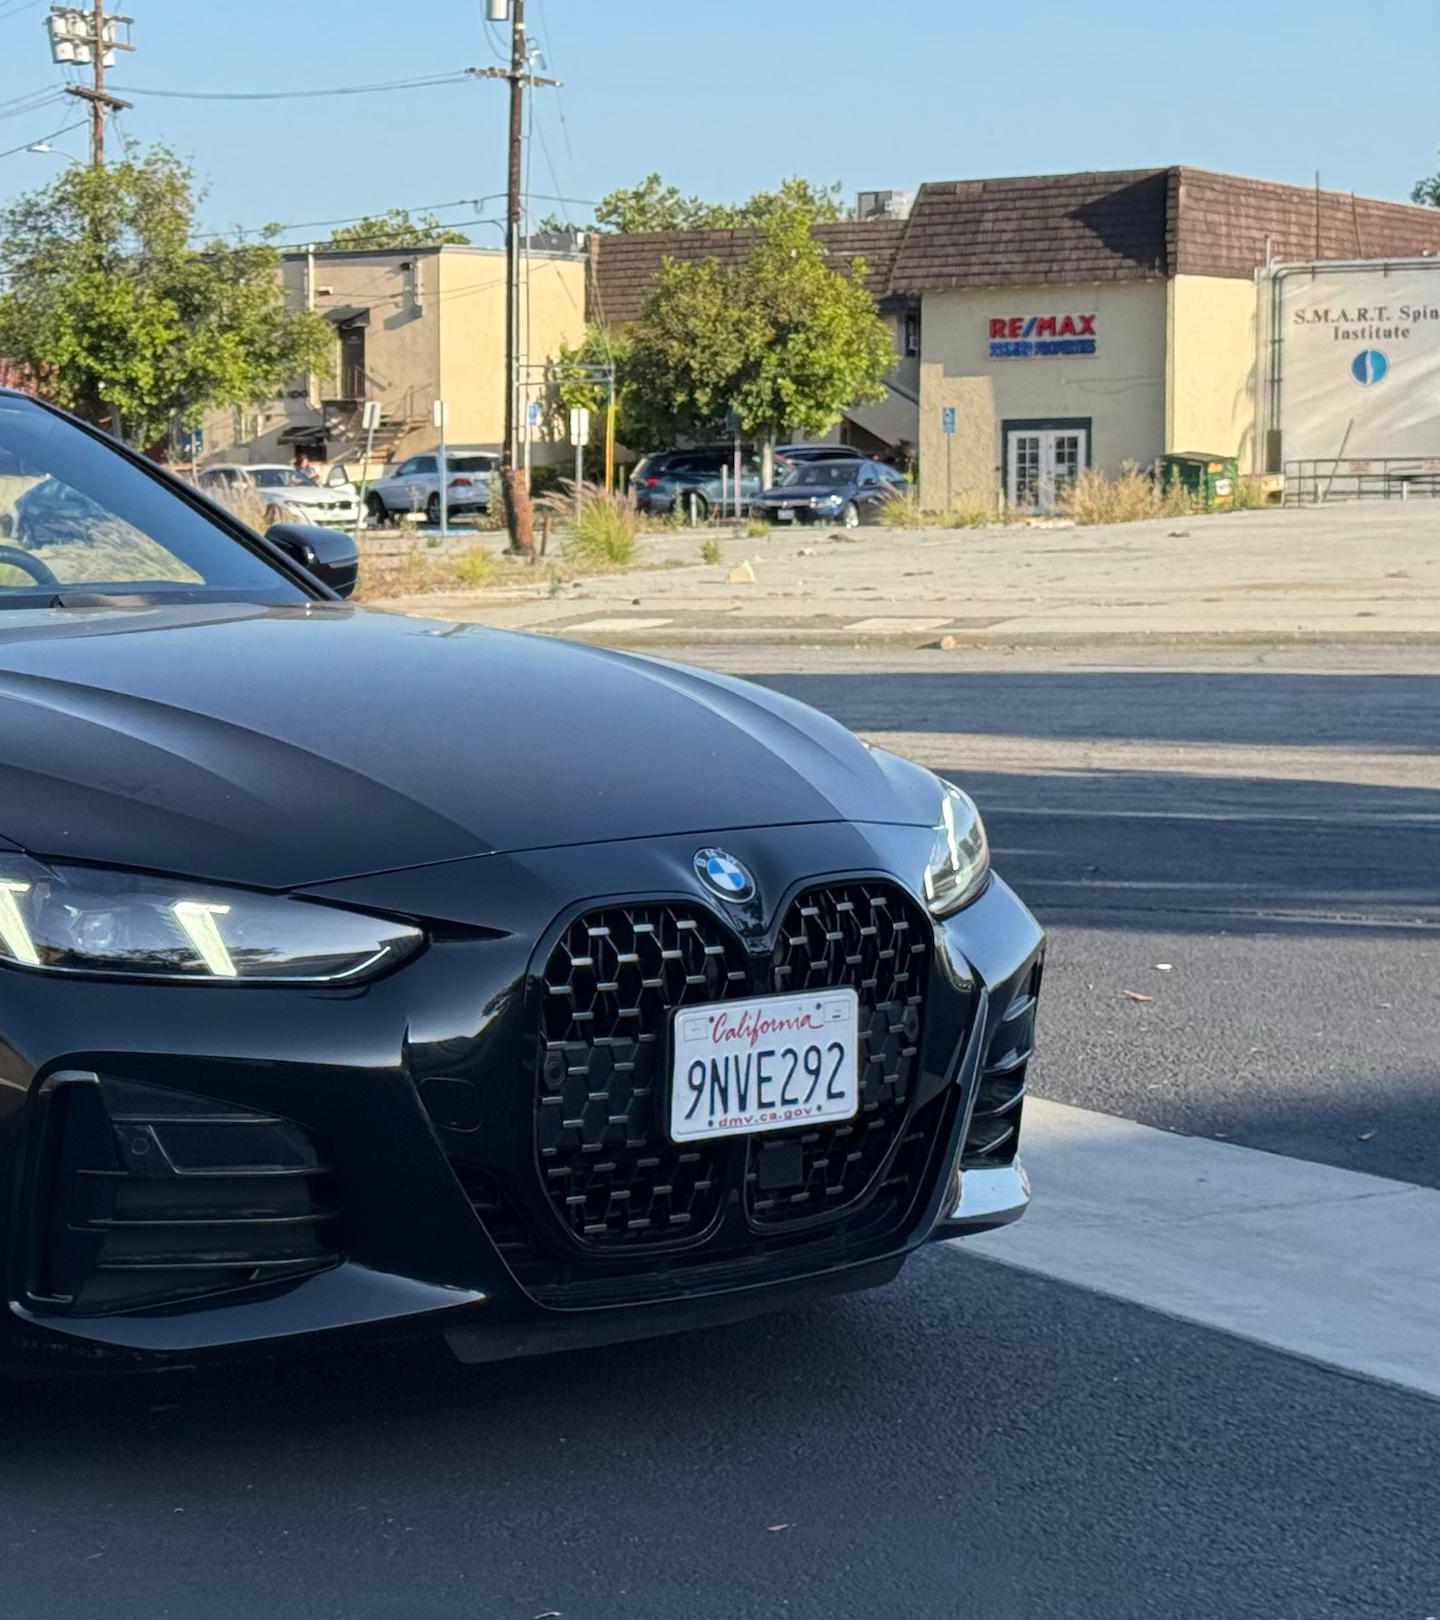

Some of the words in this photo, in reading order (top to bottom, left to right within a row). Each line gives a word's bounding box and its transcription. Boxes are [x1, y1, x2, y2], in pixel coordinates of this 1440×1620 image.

[1294, 306, 1391, 324] S.M.A.R.T.
[989, 315, 1096, 338] RE/MAX
[1334, 325, 1410, 341] Institute
[712, 1009, 824, 1048] California
[684, 1041, 846, 1120] 9NVE292
[718, 1106, 813, 1128] dmv.ca.gov
